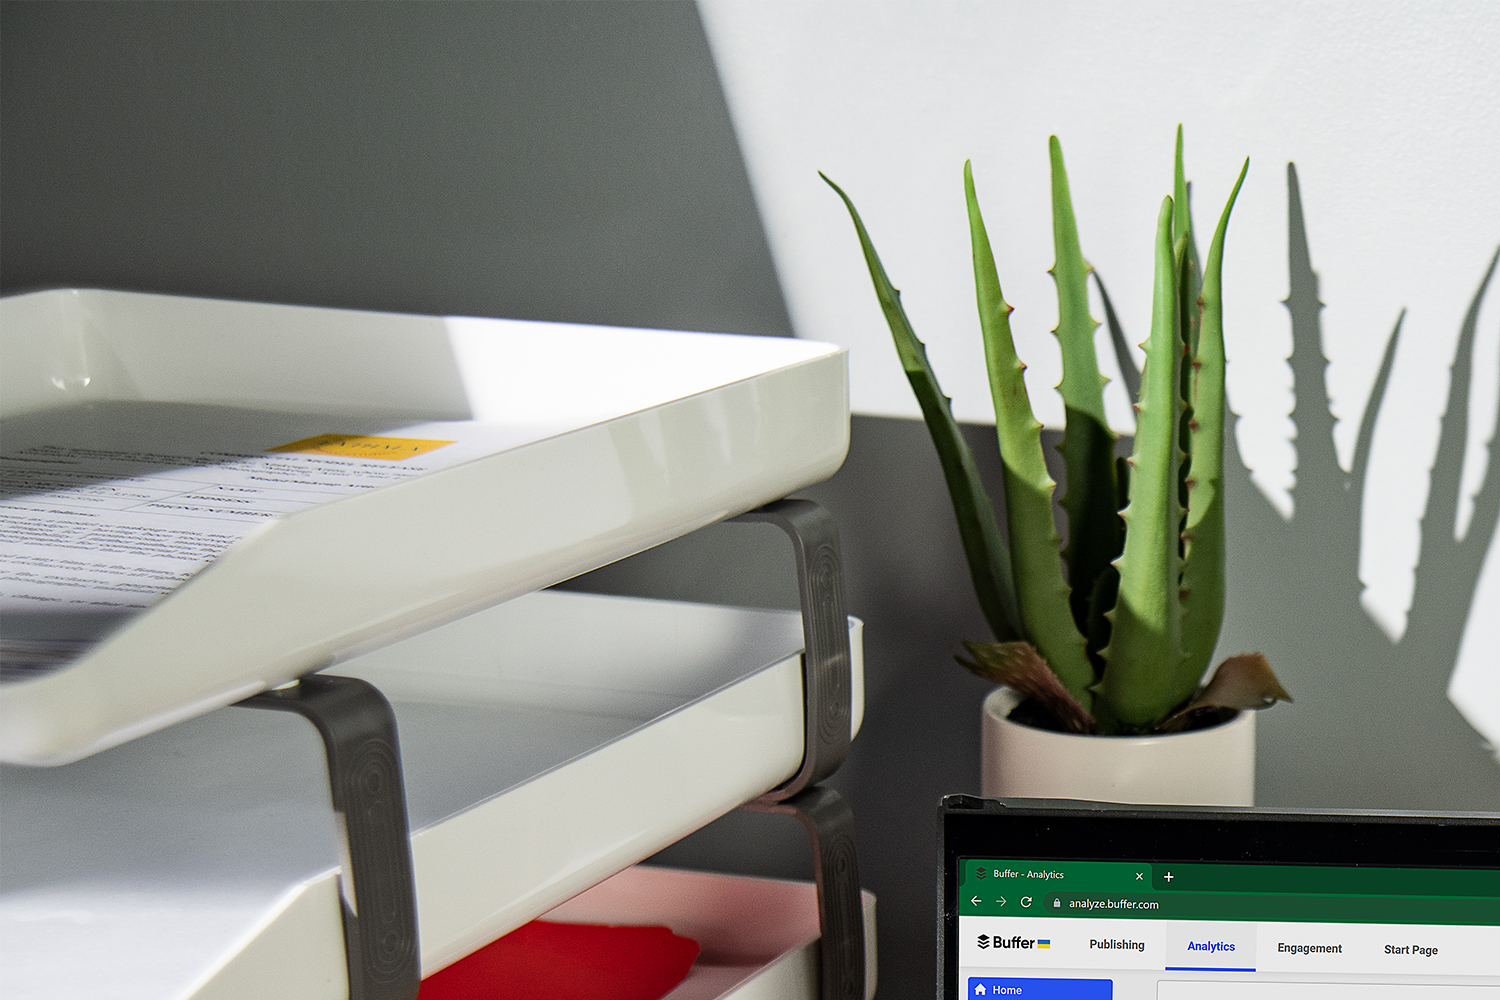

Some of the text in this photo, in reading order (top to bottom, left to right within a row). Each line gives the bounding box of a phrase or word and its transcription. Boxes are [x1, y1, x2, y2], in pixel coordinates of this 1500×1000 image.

[993, 868, 1065, 881] Buffer Analytics
[1068, 898, 1159, 911] analyze.buffer.com
[993, 935, 1036, 950] Buffer
[1089, 938, 1145, 953] Publishing
[1187, 940, 1236, 954] Analytics
[1277, 942, 1343, 956] Engagement
[1384, 944, 1439, 958] Start Page
[993, 985, 1023, 995] Home
